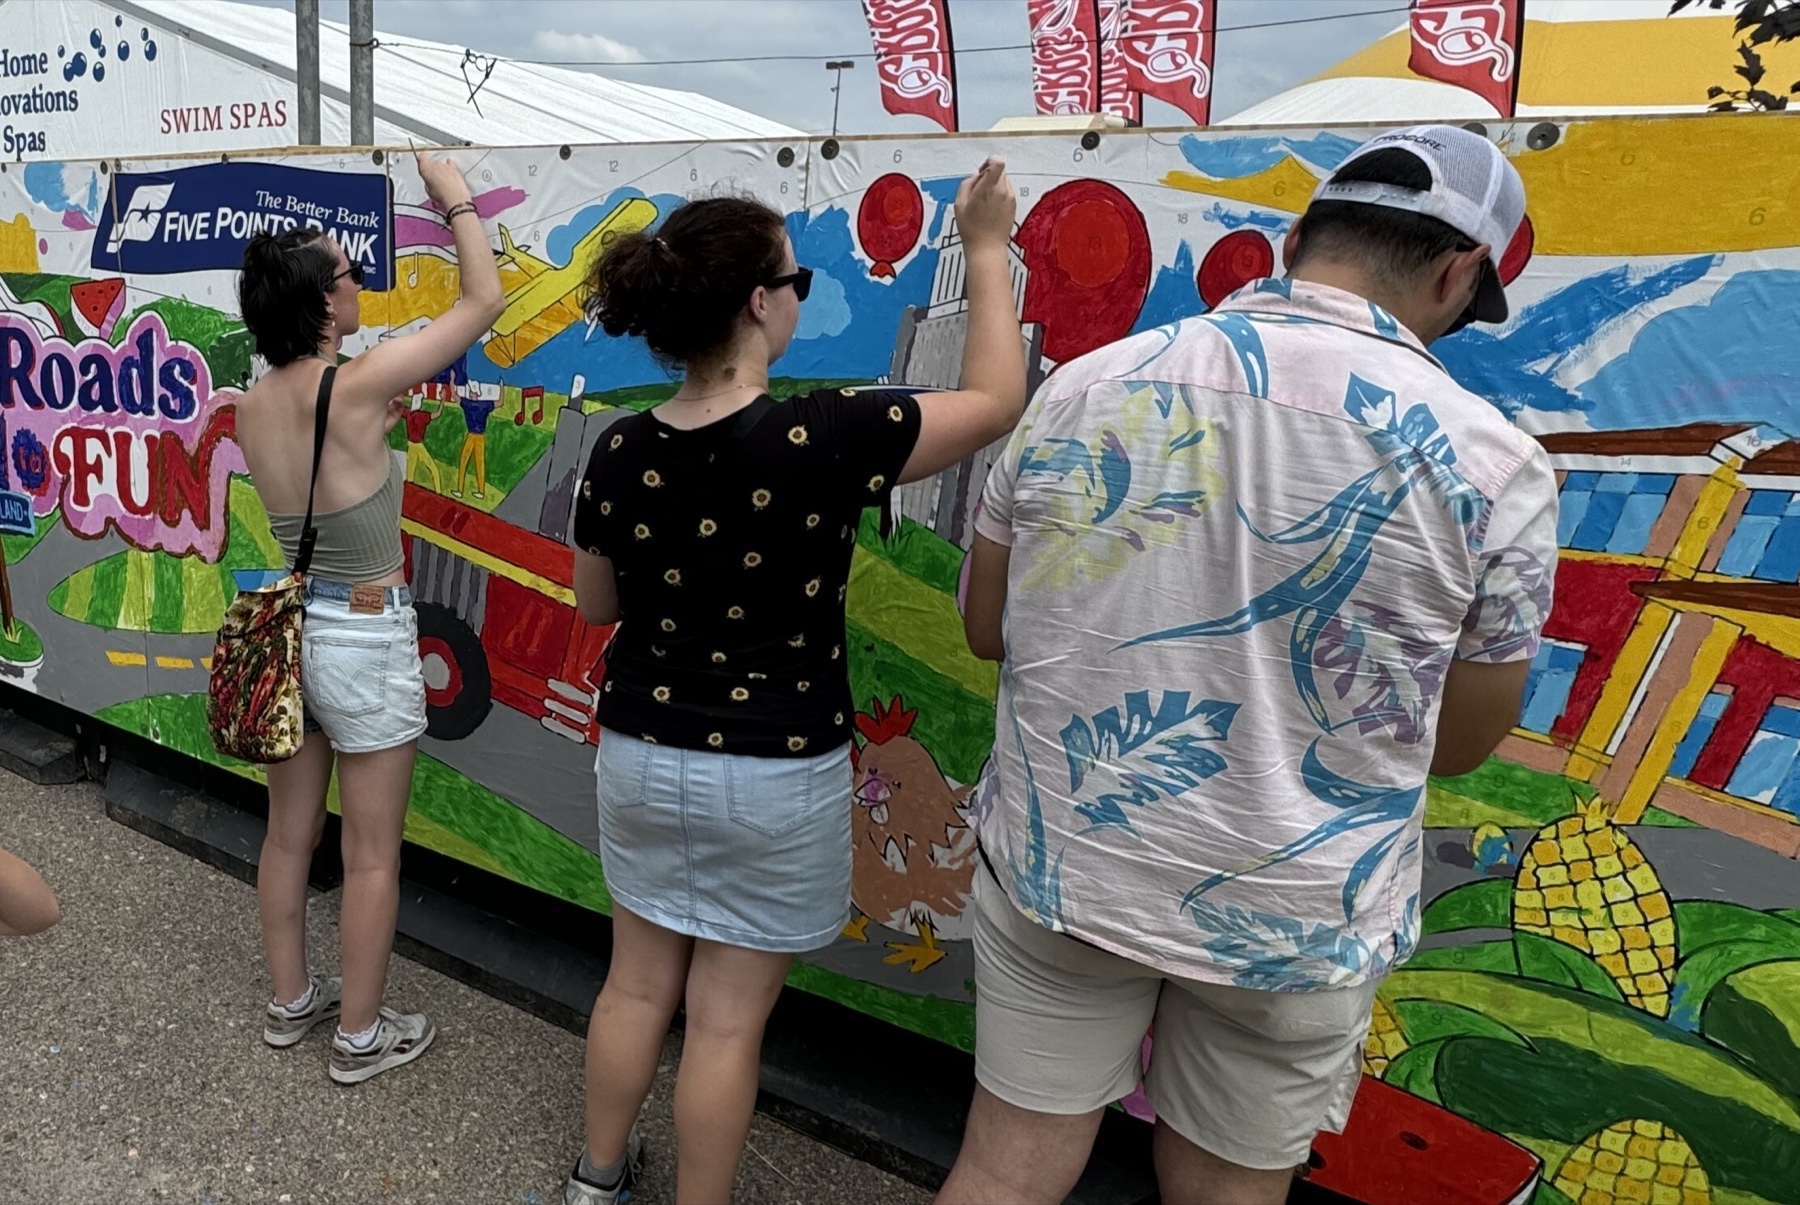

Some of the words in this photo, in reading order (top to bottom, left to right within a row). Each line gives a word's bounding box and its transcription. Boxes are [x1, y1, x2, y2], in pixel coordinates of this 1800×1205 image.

[160, 105, 223, 134] SWIM
[230, 100, 287, 130] SPAS
[3, 125, 46, 160] Spas
[893, 149, 903, 164] 6
[1073, 147, 1083, 163] 6
[528, 164, 538, 177] 12
[609, 160, 619, 173] 12
[690, 169, 698, 182] 6
[780, 181, 788, 194] 6
[1019, 187, 1029, 198] 18
[1273, 180, 1287, 197] 6
[255, 190, 282, 209] The
[285, 195, 333, 220] Better
[336, 206, 380, 228] Bank
[1749, 207, 1766, 226] 6
[163, 211, 211, 243] FIVE
[214, 206, 298, 240] POINTS
[1177, 213, 1188, 224] 18
[533, 230, 541, 242] 6
[0, 327, 198, 421] Roads
[1745, 435, 1762, 448] 16
[53, 426, 236, 531] FUN
[1697, 516, 1711, 530] 6
[1453, 950, 1465, 965] 9
